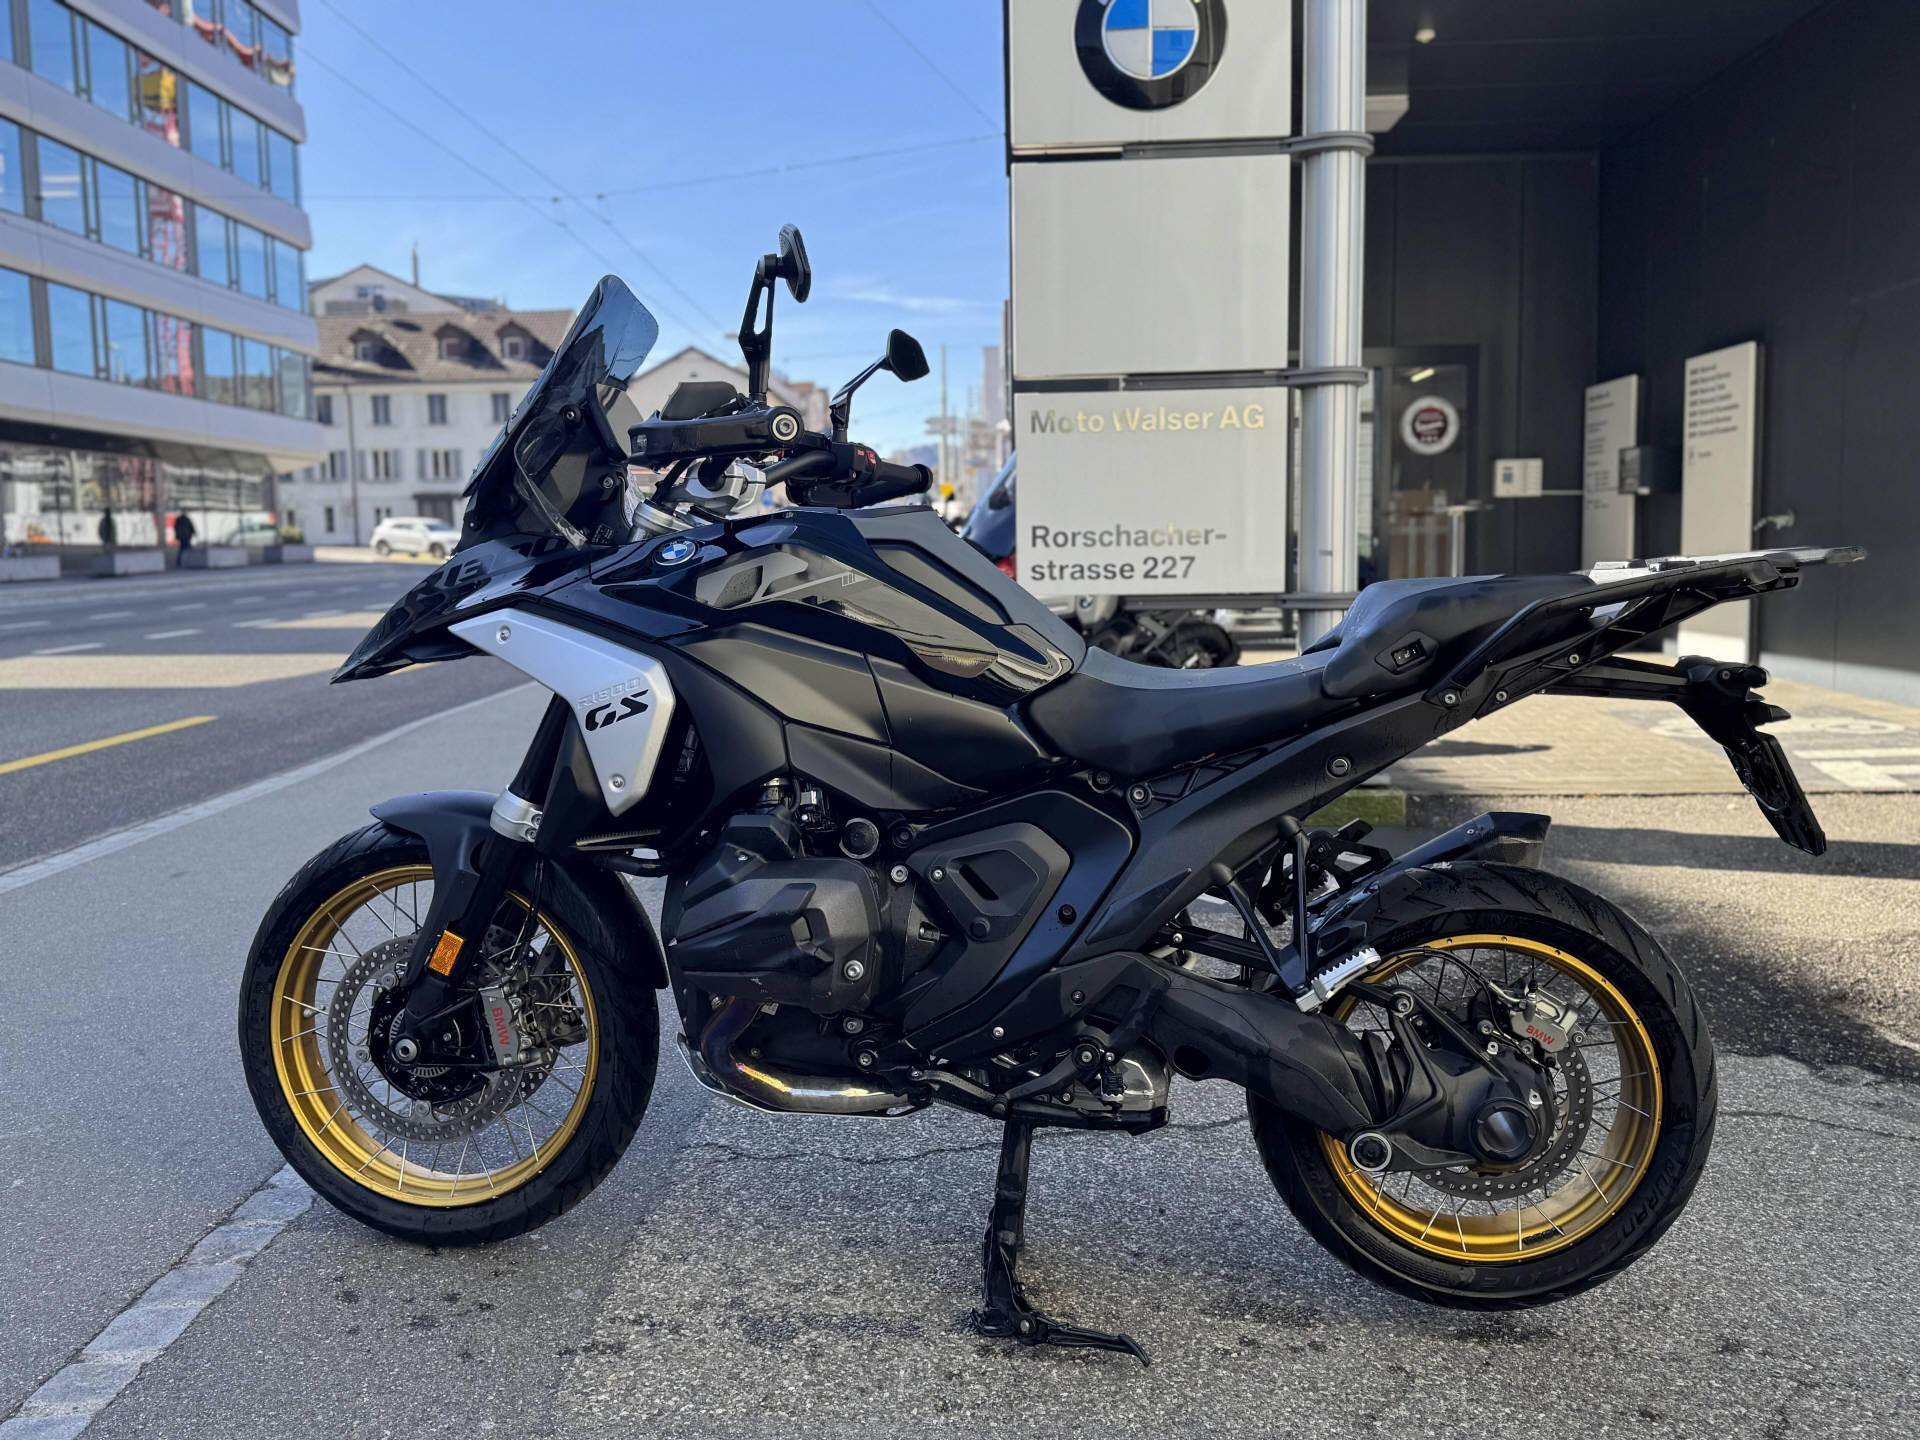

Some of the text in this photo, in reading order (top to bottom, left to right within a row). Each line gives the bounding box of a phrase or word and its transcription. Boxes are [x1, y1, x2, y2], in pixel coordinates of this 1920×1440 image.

[1030, 403, 1265, 434] Moto Walser AG
[1030, 523, 1228, 548] Rorschacher-
[1030, 555, 1197, 582] strasse 227
[585, 688, 649, 731] GS
[492, 1006, 511, 1047] BMW
[1525, 1024, 1556, 1046] BMW
